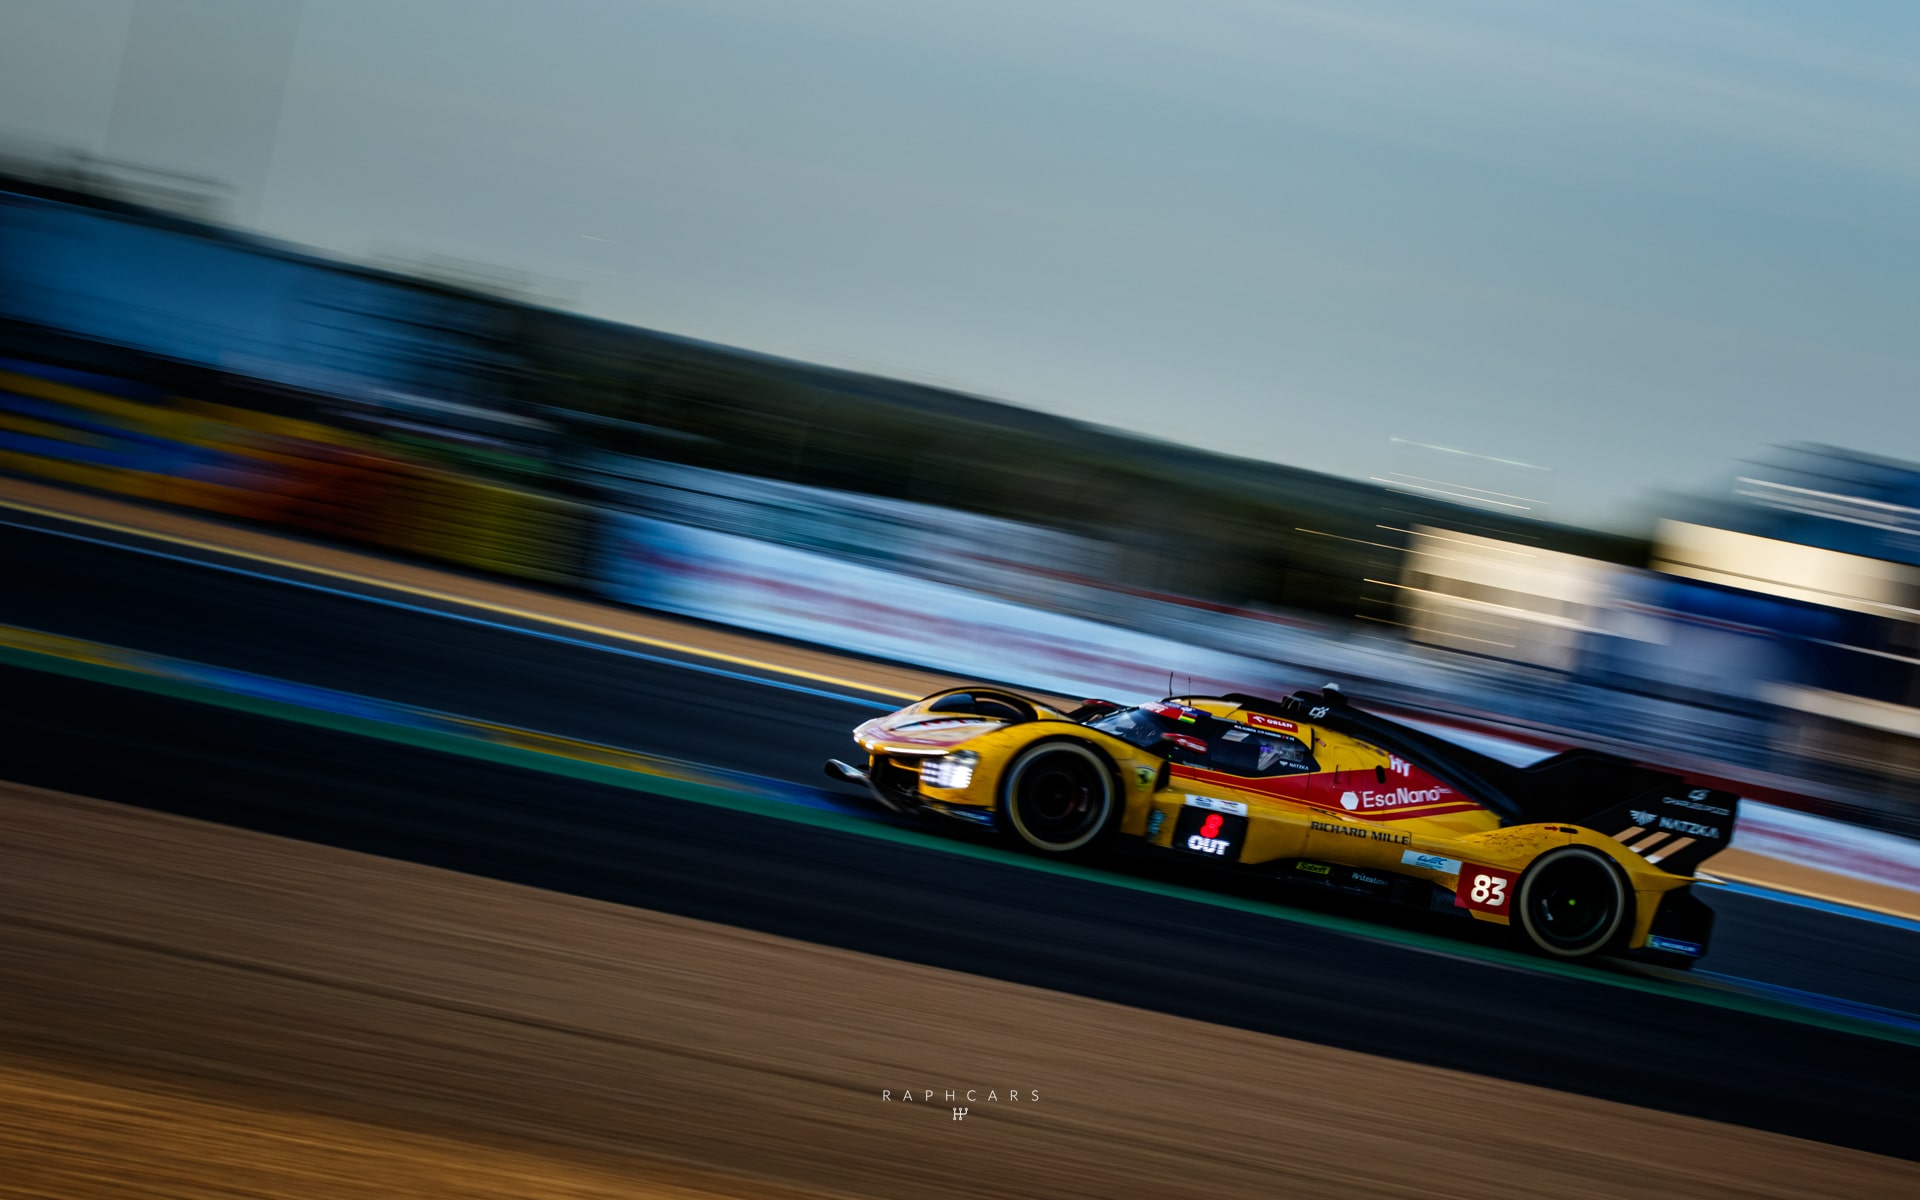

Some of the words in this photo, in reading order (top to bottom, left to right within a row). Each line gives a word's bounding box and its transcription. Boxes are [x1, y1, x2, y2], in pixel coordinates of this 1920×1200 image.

[1266, 719, 1293, 729] ORLEN
[1289, 762, 1309, 770] NATZKA
[1362, 787, 1441, 808] EsaNano
[1199, 813, 1225, 839] 8
[1310, 821, 1366, 838] RICHARD
[1371, 831, 1409, 845] MILLE
[1658, 817, 1720, 838] NATZKA
[1187, 834, 1230, 856] OUT
[1471, 874, 1507, 906] 83
